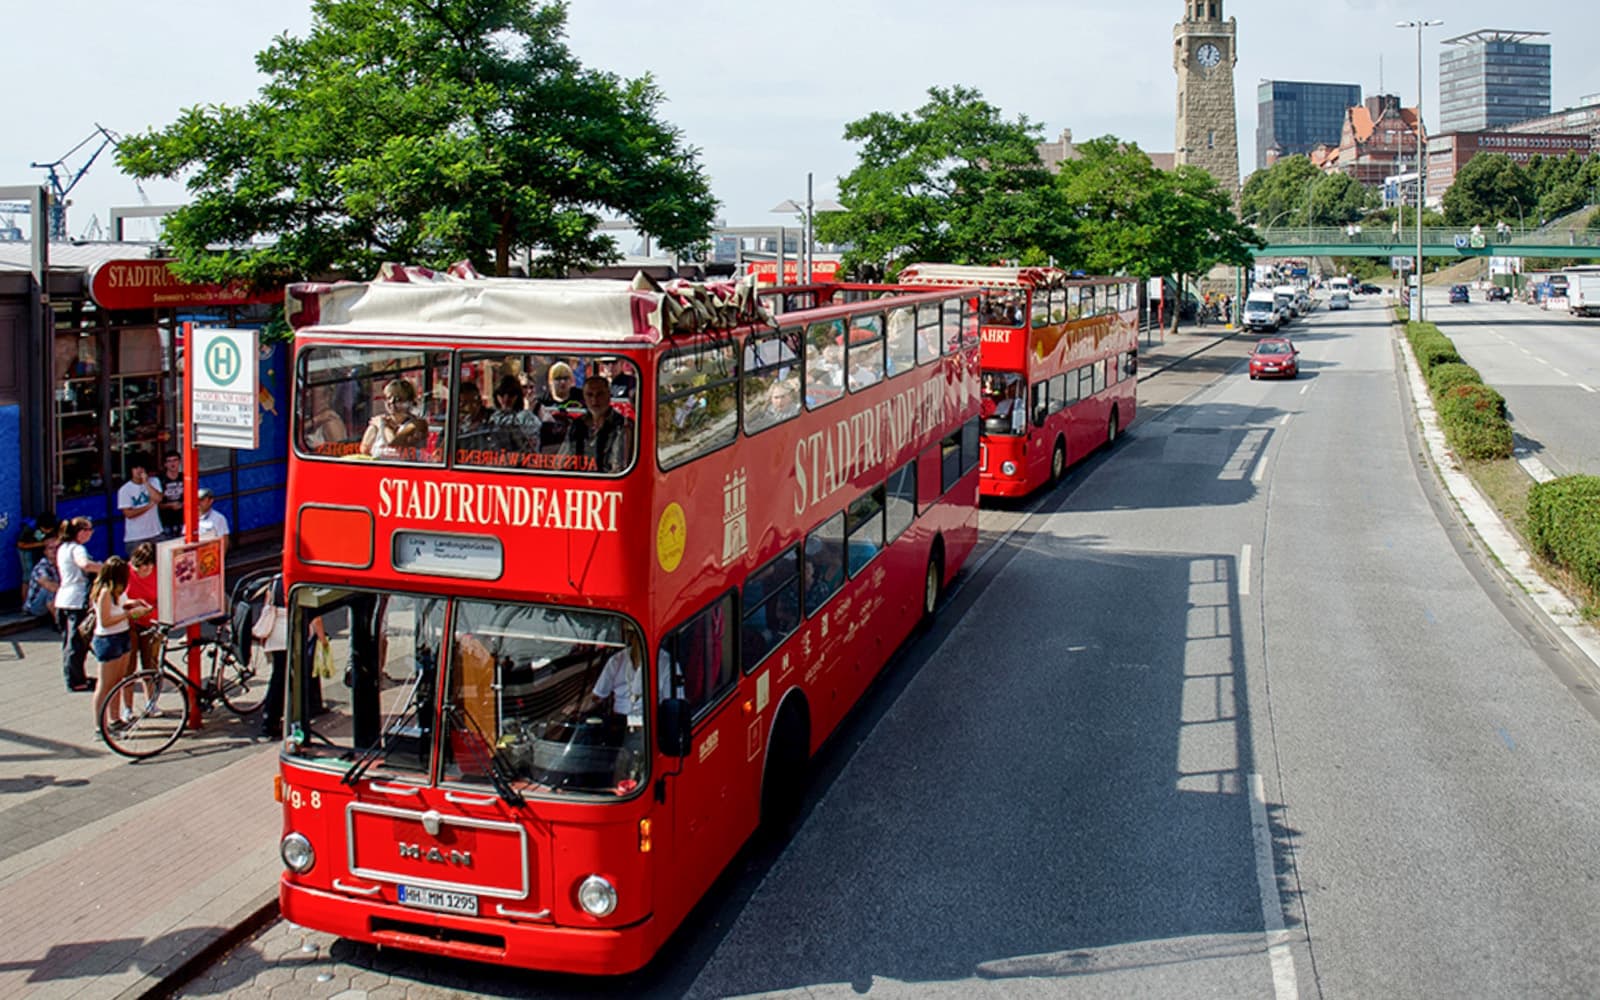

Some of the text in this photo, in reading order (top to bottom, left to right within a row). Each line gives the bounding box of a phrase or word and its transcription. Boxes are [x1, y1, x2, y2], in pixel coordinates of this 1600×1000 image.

[108, 265, 172, 288] STADTRU
[214, 346, 231, 375] H
[378, 477, 623, 532] STADTRUNDFAHRT
[310, 790, 322, 809] 8
[447, 894, 476, 911] 1295
